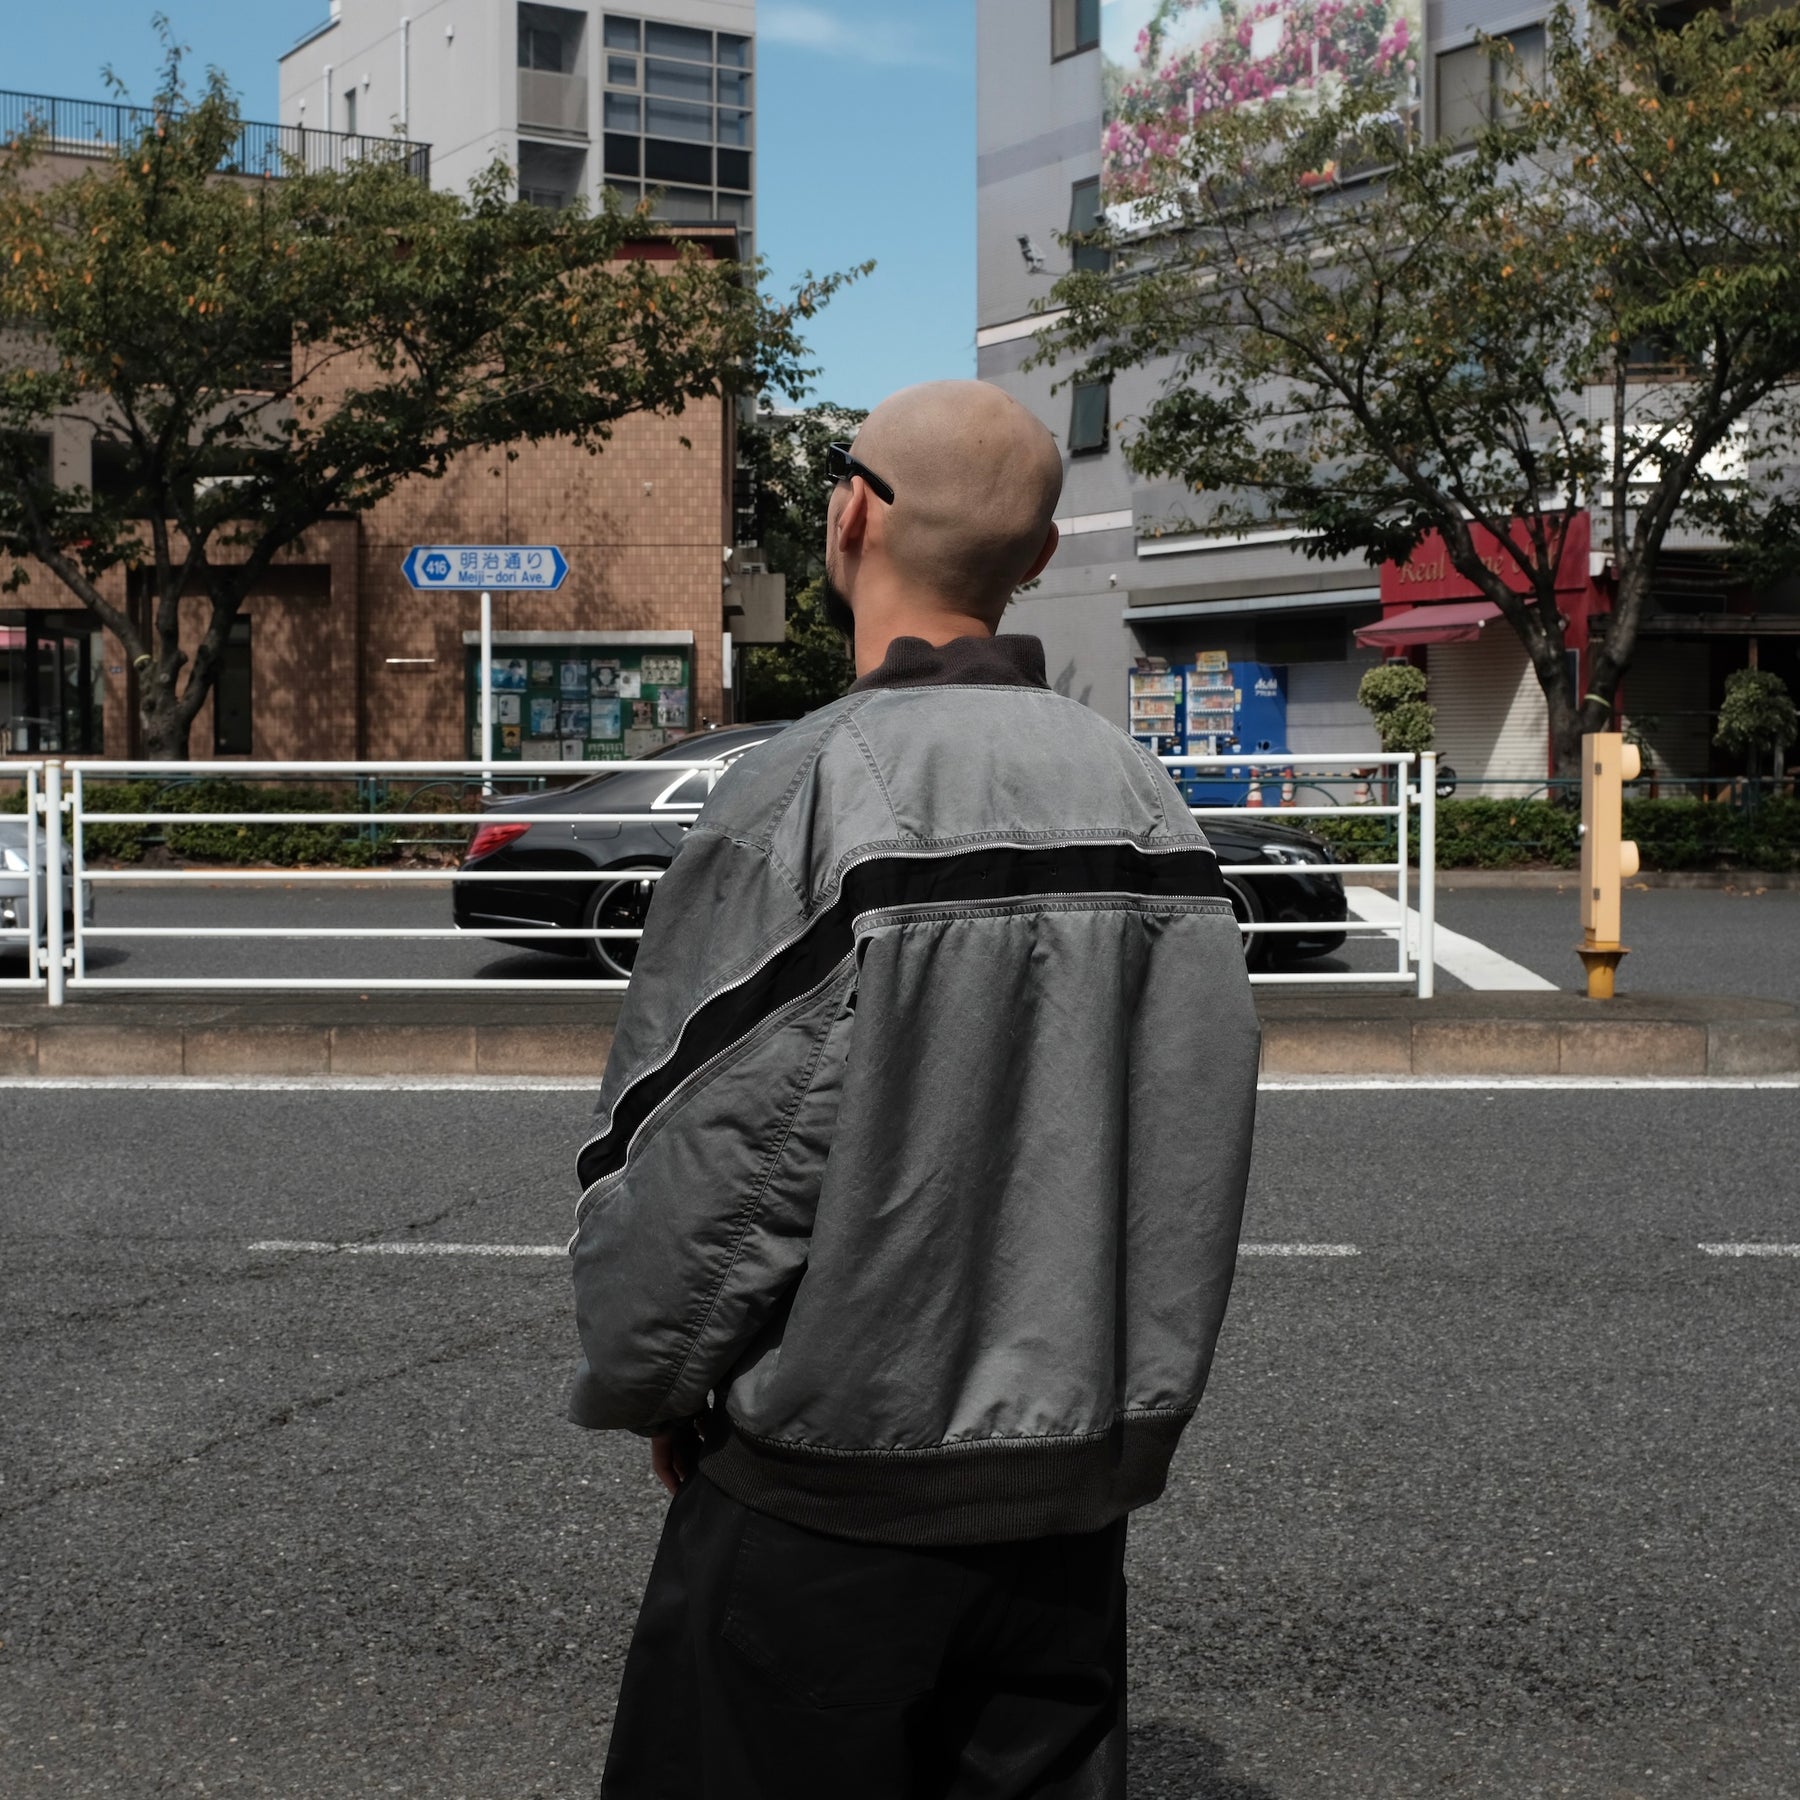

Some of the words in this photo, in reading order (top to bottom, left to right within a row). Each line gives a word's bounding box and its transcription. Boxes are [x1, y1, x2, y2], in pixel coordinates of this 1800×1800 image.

[426, 561, 447, 575] 416
[460, 552, 542, 570] 明治通り
[1400, 551, 1445, 583] Real
[458, 571, 517, 585] Meiji-dori
[521, 572, 546, 583] Ave.
